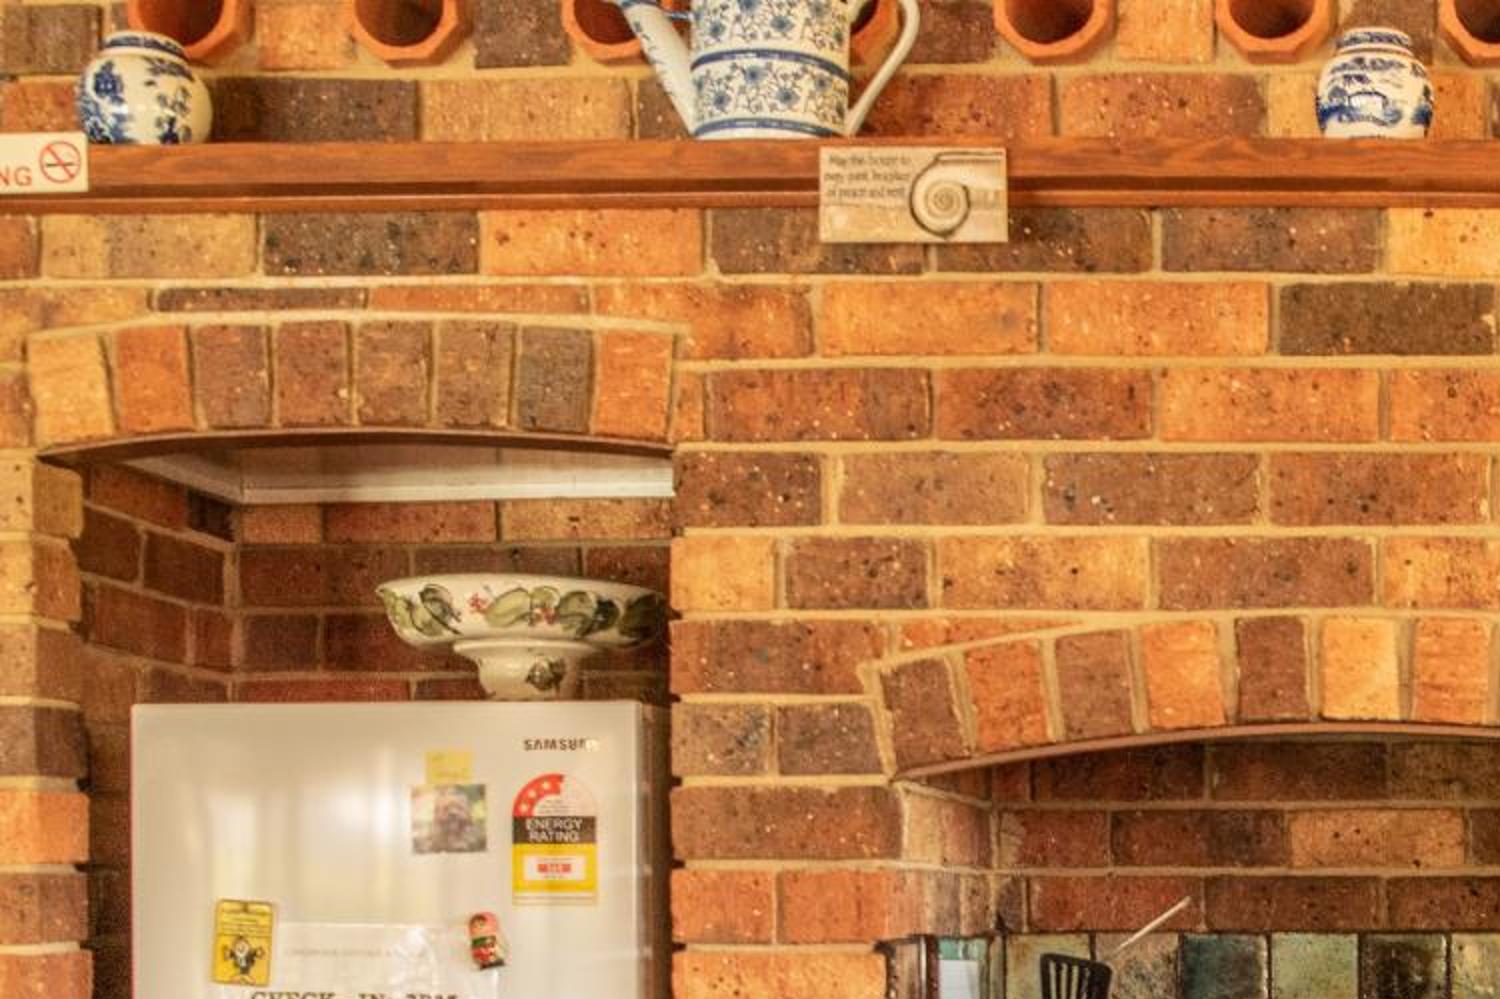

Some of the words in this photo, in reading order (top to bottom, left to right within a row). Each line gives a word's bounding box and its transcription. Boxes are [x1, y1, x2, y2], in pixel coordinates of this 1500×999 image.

[523, 739, 598, 751] SAMSU
[525, 819, 583, 831] ENERGY
[528, 831, 580, 842] RATING
